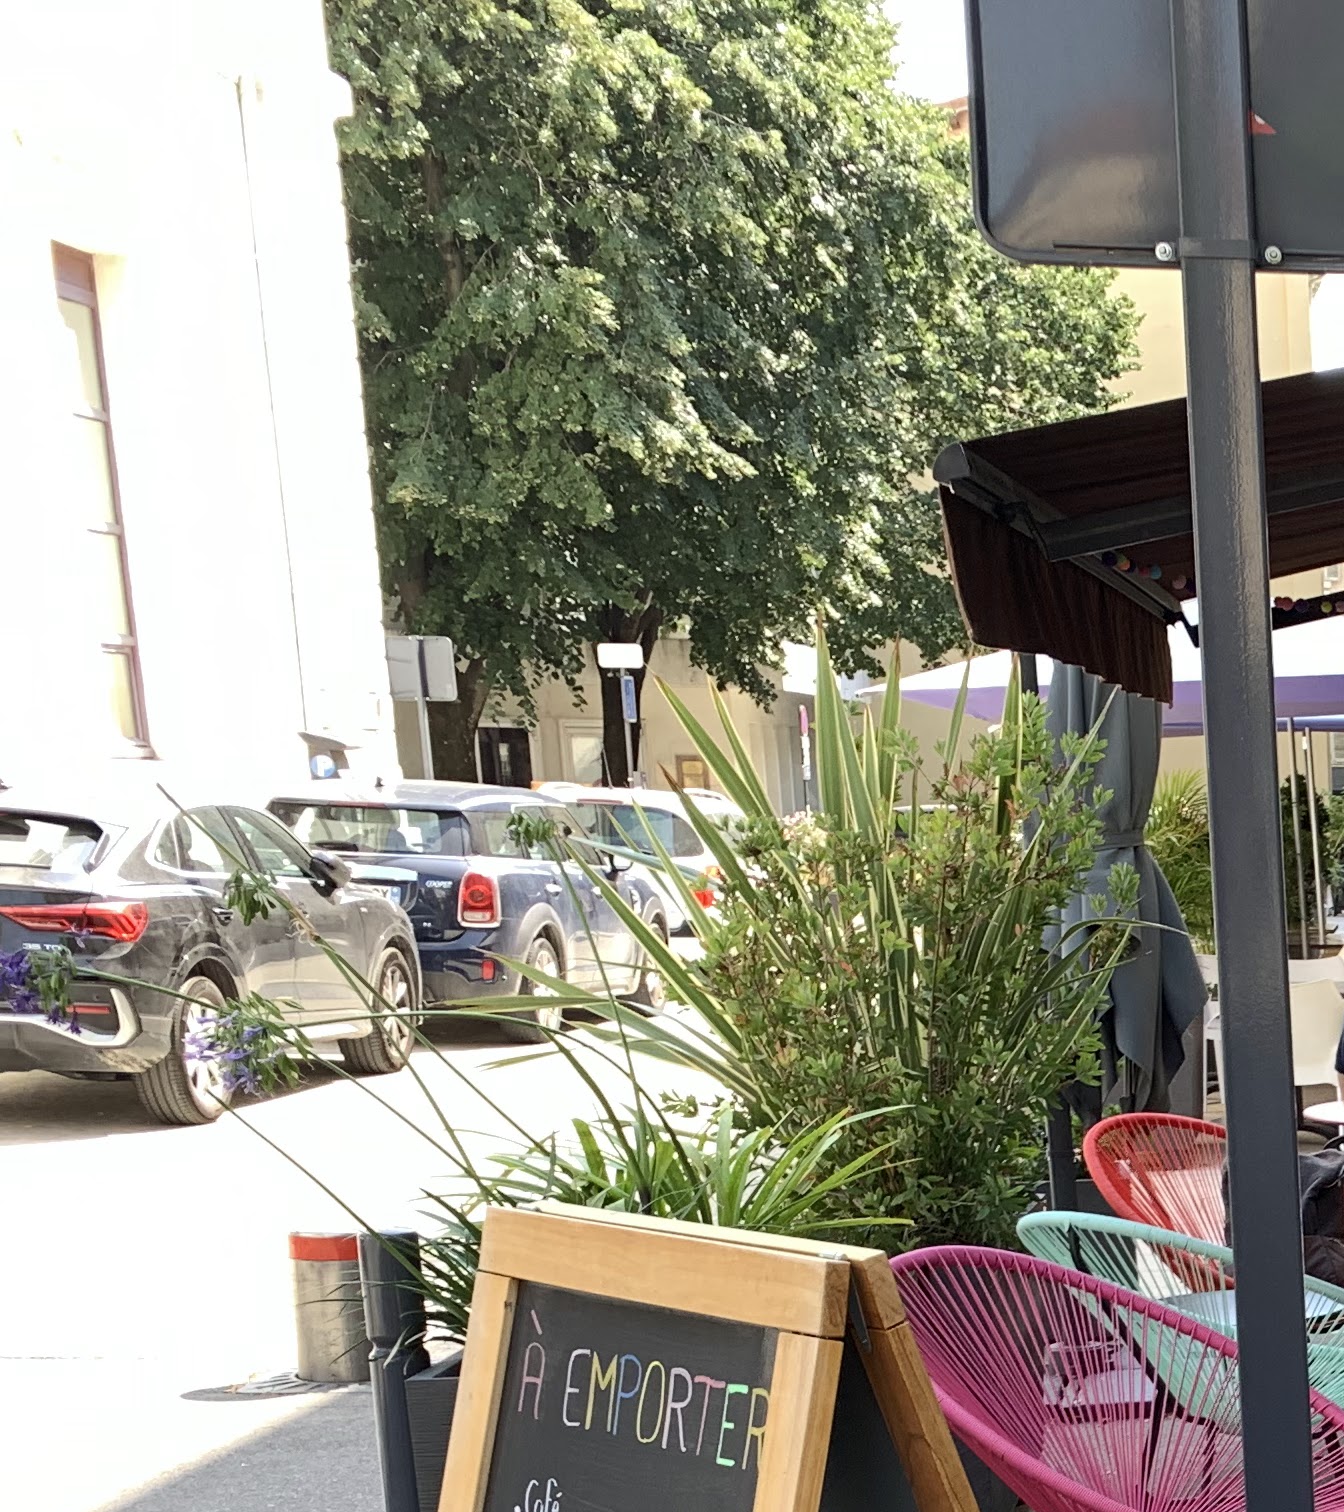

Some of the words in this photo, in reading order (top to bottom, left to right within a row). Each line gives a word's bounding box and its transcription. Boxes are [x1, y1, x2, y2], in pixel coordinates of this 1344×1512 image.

[316, 755, 334, 777] P
[518, 1309, 545, 1420] À
[562, 1349, 770, 1471] EMPORTER
